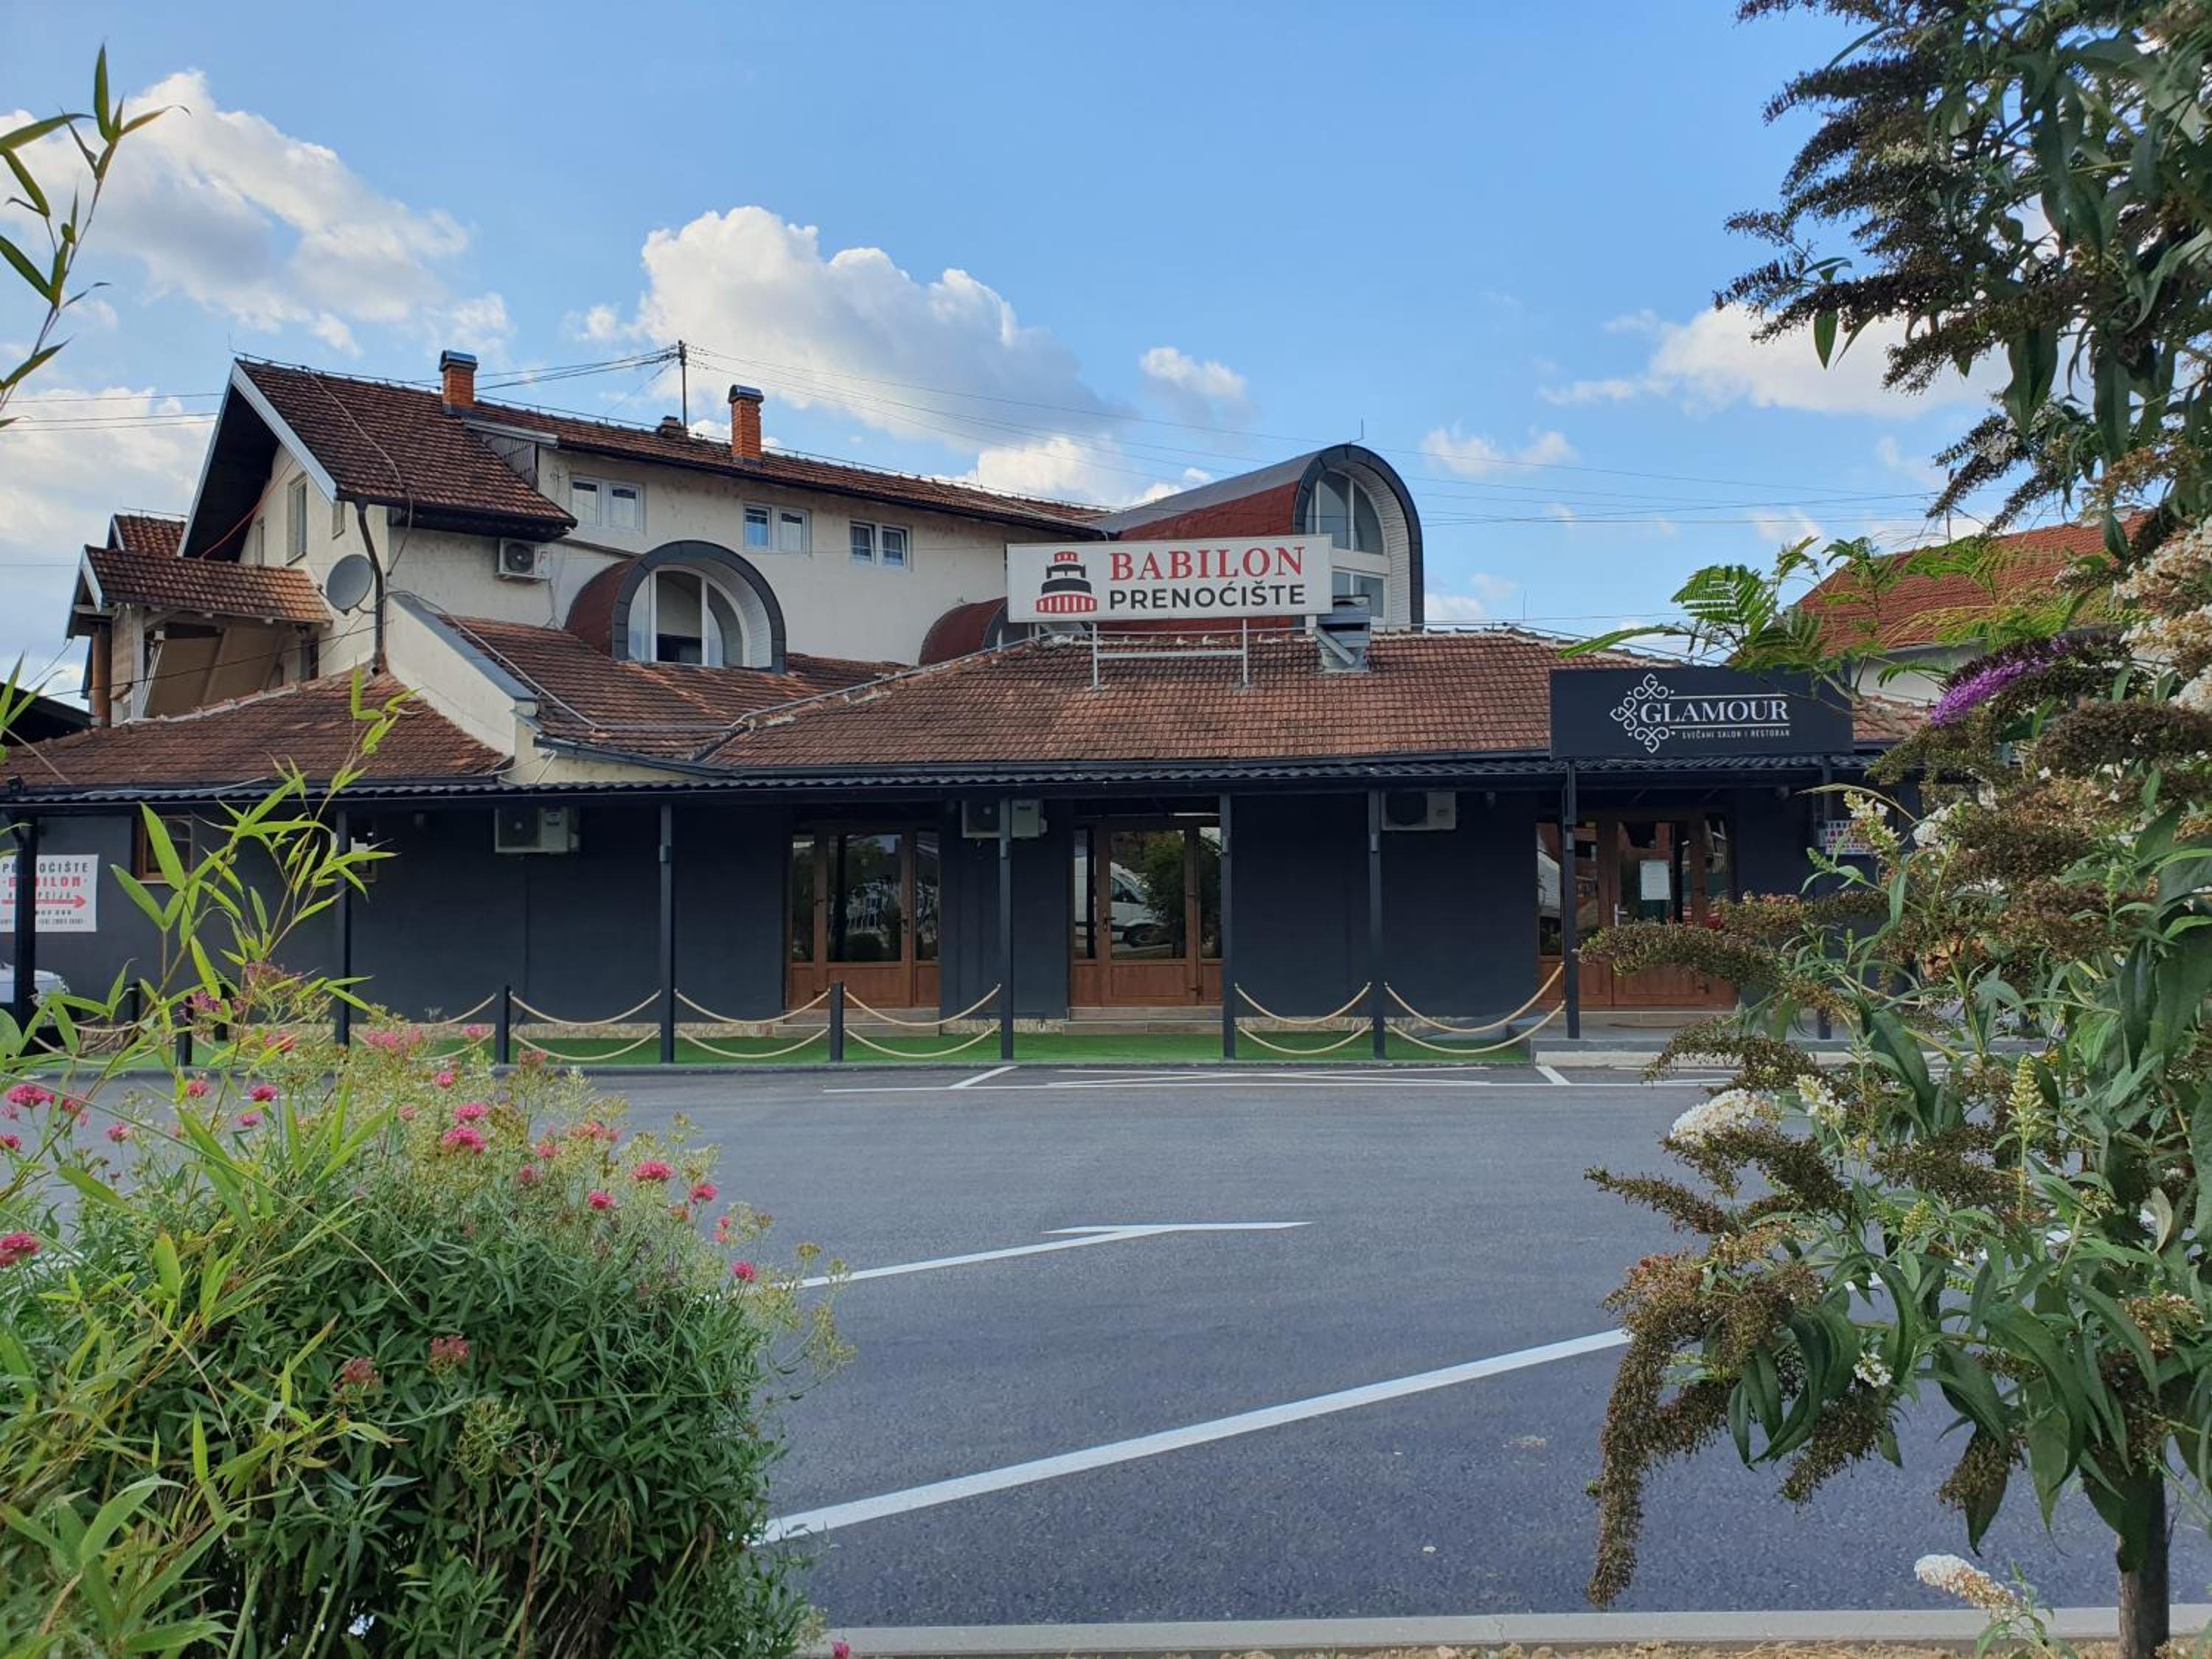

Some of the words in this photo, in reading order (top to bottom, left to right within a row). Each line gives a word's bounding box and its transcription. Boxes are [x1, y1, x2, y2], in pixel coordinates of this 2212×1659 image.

[1109, 546, 1305, 581] BABILON
[1109, 580, 1306, 610] PRENOĆIŠTE
[1640, 700, 1790, 723] GLAMOUR
[1718, 730, 1742, 738] SALON
[1750, 729, 1790, 737] RESTORAN
